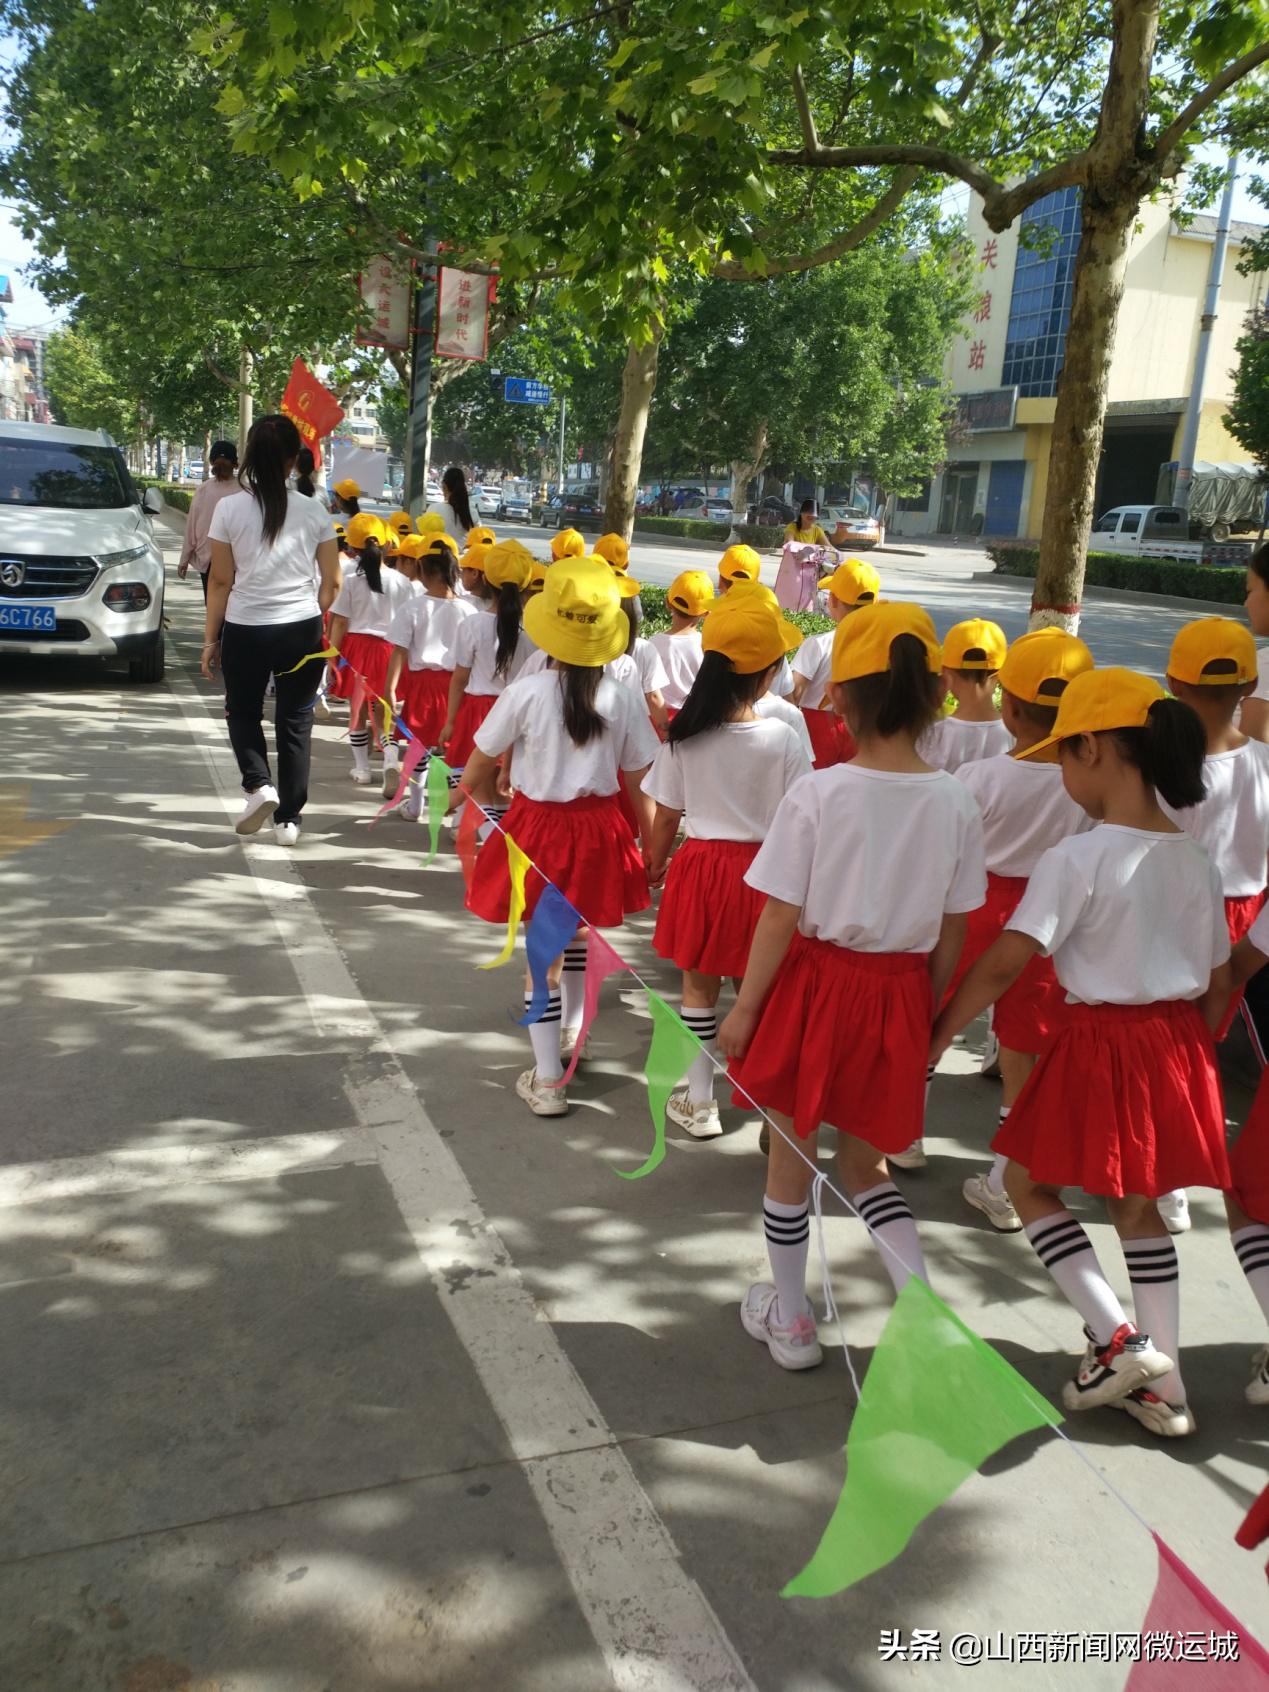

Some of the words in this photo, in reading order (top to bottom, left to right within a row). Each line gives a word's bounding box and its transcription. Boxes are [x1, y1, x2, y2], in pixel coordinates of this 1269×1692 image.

[455, 271, 473, 341] 进新时代
[0, 608, 53, 626] 6C766
